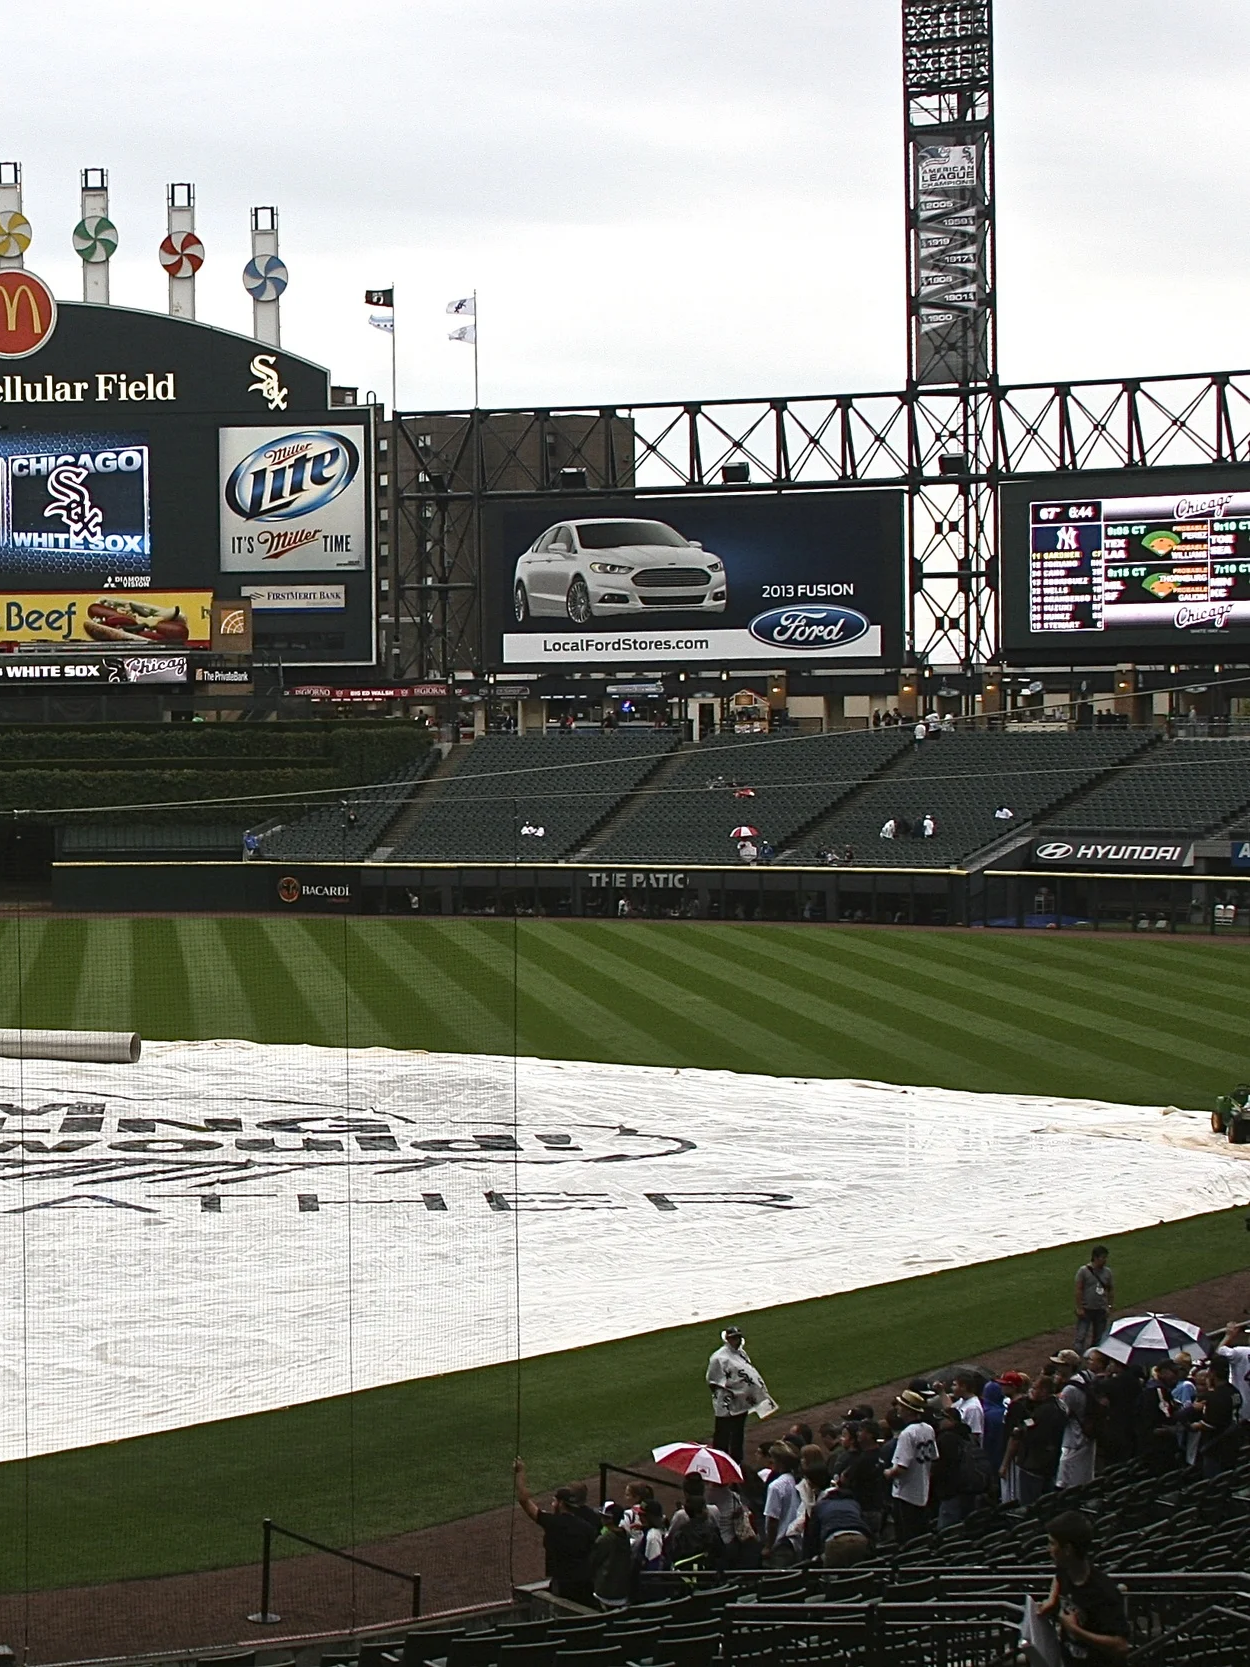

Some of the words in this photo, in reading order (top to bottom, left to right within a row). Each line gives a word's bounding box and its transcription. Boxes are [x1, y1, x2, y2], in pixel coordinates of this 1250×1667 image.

[922, 165, 975, 175] AMERICAN
[922, 171, 975, 182] LEAGUE
[922, 180, 975, 189] CHAMPIONS
[95, 373, 176, 402] Field
[264, 442, 313, 467] Miller
[244, 447, 340, 522] Lite
[1174, 494, 1234, 518] Chicago
[1131, 525, 1147, 535] CT
[13, 531, 85, 550] WHITE
[95, 532, 143, 554] SOX
[231, 535, 255, 554] IT'S
[257, 528, 323, 560] Miller
[322, 535, 351, 553] TIME
[1104, 539, 1126, 548] TEX
[1131, 567, 1147, 576] CT
[123, 580, 150, 588] VISION
[762, 584, 795, 598] 2013
[797, 583, 854, 598] FUSION
[320, 591, 342, 600] BANK
[6, 602, 76, 639] Beef
[1174, 602, 1235, 628] Chicago
[772, 611, 845, 643] Ford
[543, 638, 710, 653] LocalFordStores.com
[6, 665, 61, 678] WHITE
[64, 664, 100, 678] SOX
[204, 671, 215, 681] The
[1077, 844, 1182, 861] HYUNDAI
[588, 873, 627, 887] THE
